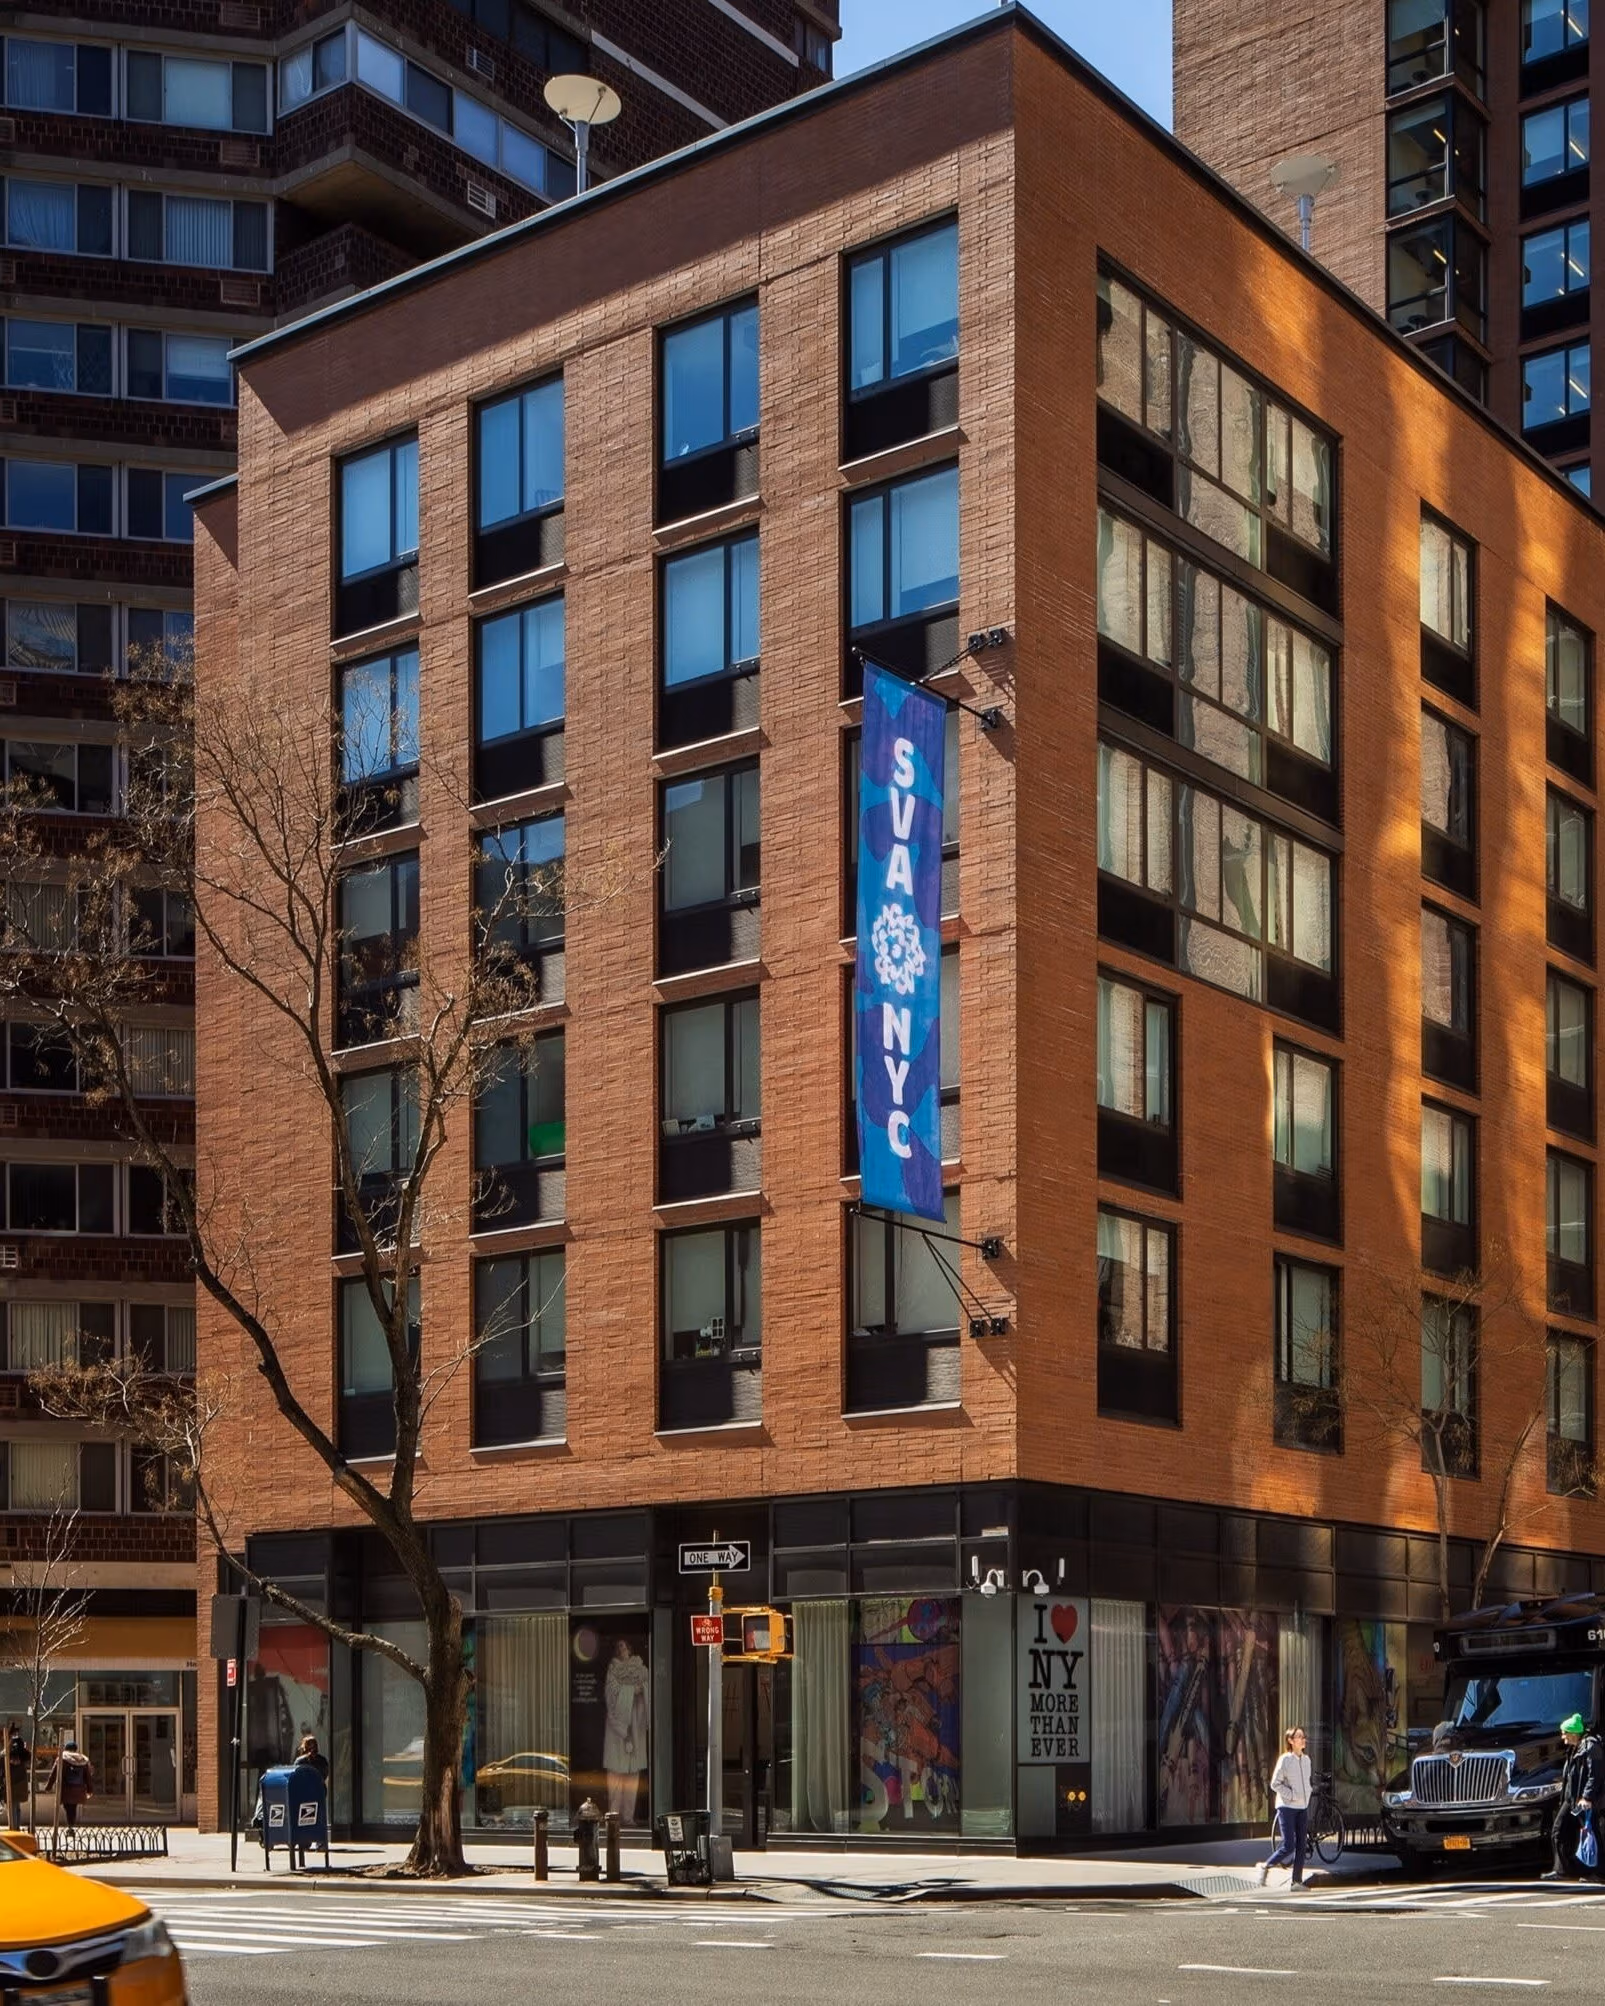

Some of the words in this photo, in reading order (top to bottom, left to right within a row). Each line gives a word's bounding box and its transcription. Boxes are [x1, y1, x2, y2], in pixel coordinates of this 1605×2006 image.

[886, 737, 914, 895] SVA
[882, 1002, 912, 1159] NYC
[689, 1553, 709, 1565] ONE
[717, 1551, 739, 1563] WAY
[1033, 1604, 1048, 1644] I
[1587, 1628, 1605, 1641] 61
[1028, 1649, 1084, 1690] NY
[1030, 1693, 1079, 1713] MORE
[1030, 1715, 1080, 1735] THAN
[1031, 1738, 1080, 1758] EVER
